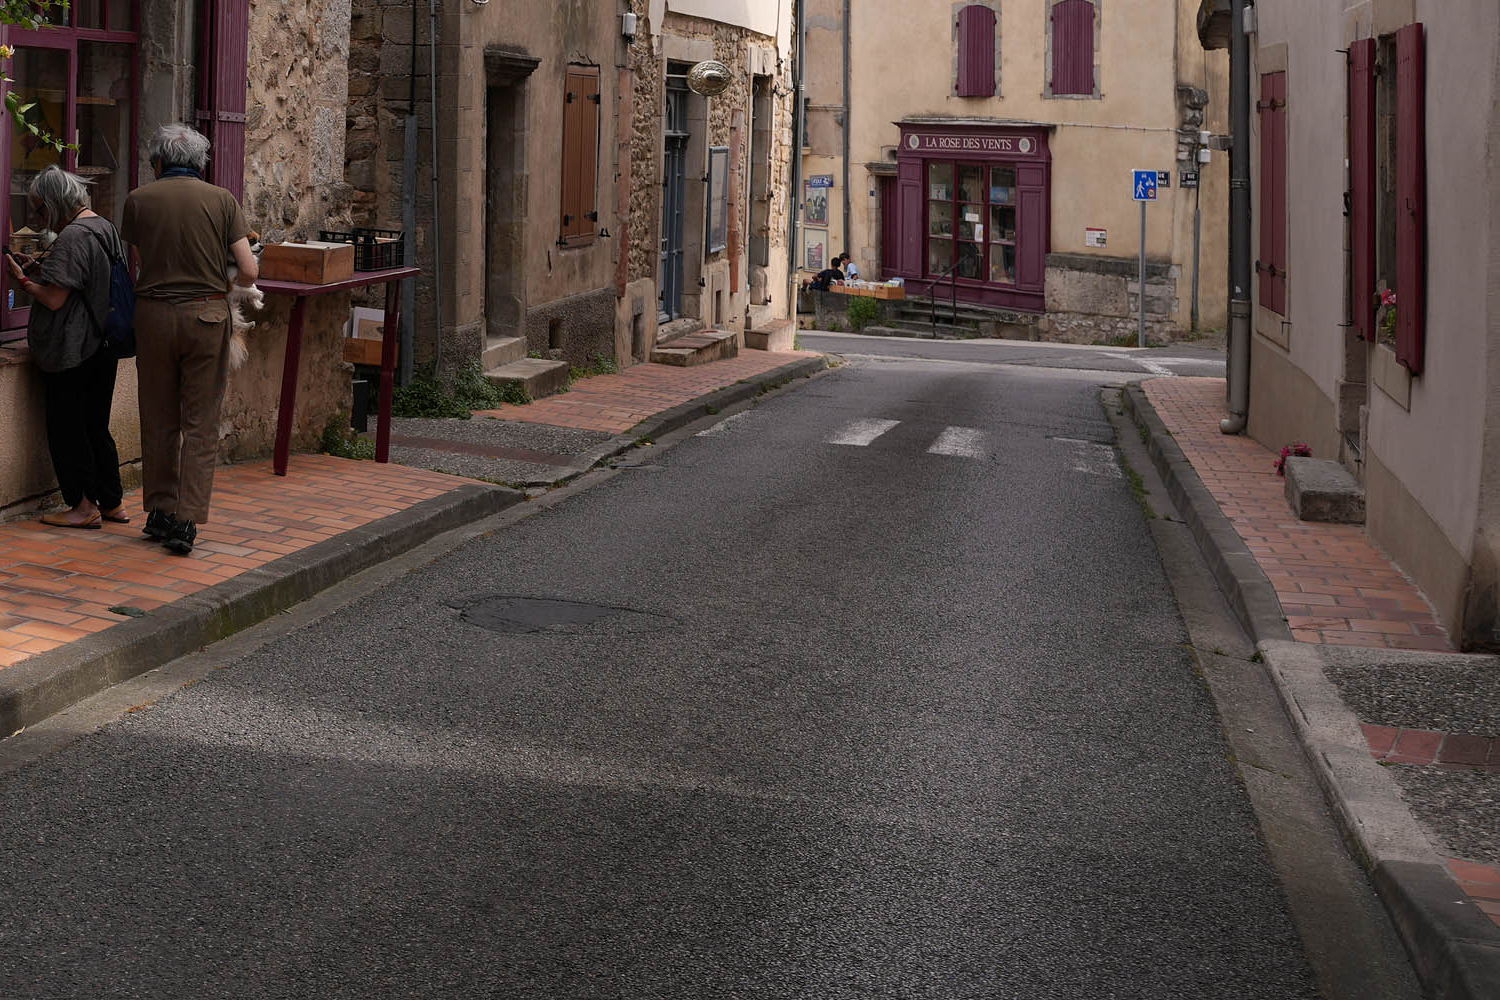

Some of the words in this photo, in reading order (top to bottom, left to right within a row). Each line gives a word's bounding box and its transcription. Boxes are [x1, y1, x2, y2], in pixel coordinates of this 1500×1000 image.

[925, 137, 937, 148] LA
[939, 138, 961, 149] ROSE
[963, 138, 980, 149] DES
[982, 139, 1012, 150] VENTS
